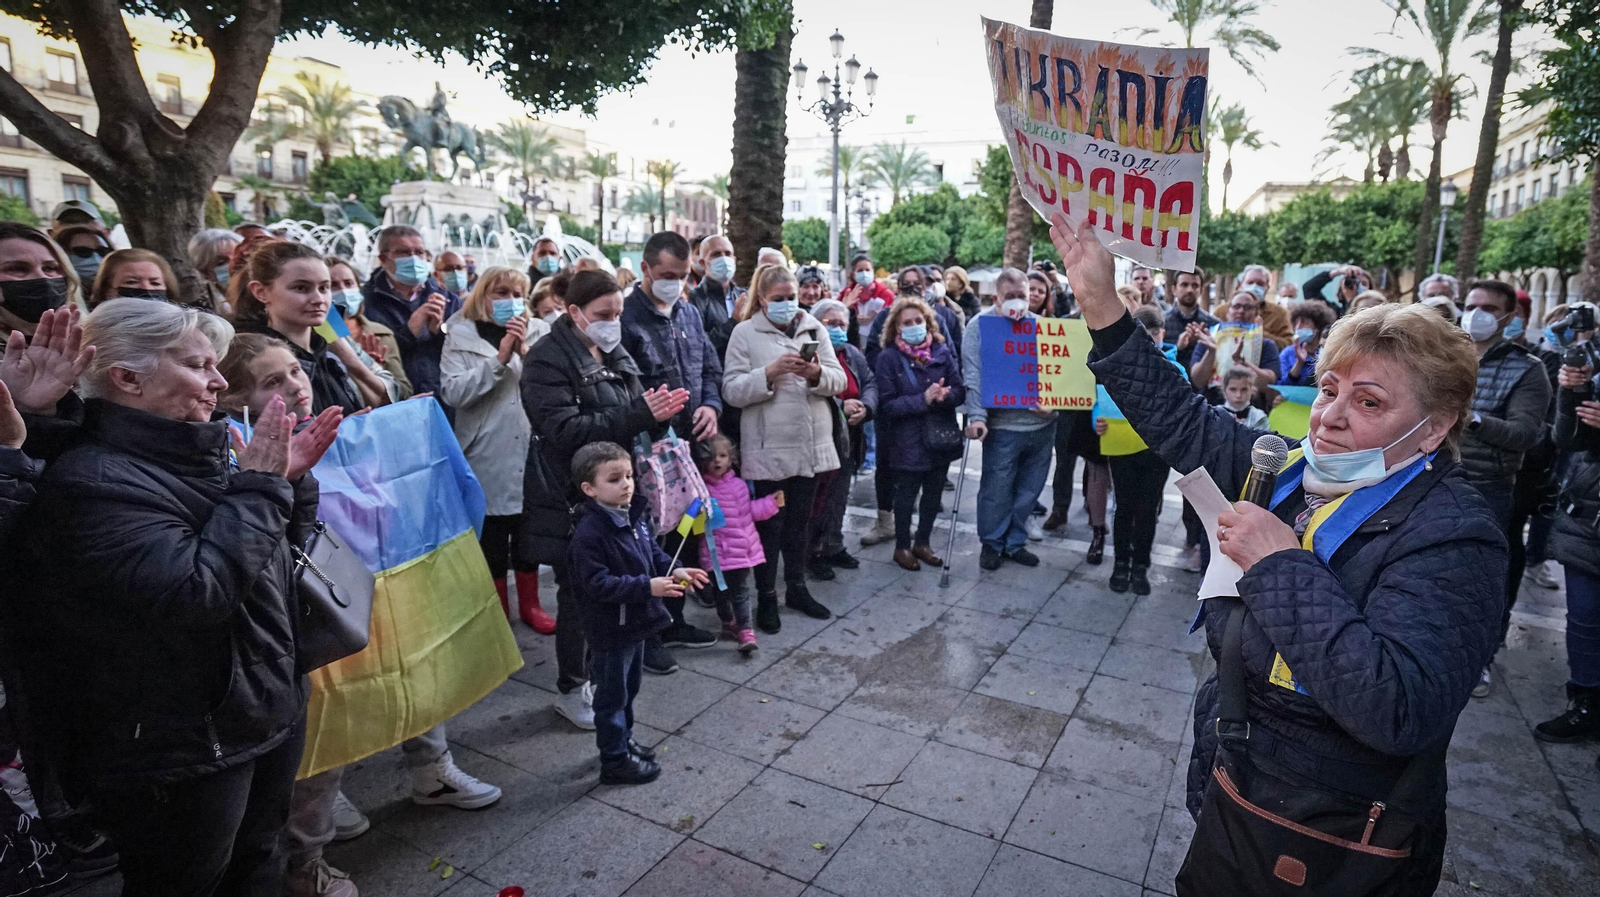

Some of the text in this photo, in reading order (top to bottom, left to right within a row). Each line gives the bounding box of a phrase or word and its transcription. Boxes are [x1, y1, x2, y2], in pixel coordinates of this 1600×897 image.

[1014, 128, 1194, 251] ESPAÑA
[1012, 321, 1066, 336] NO A LA
[1004, 341, 1070, 357] GUERRA
[1018, 363, 1061, 374] JEREZ
[1026, 382, 1052, 392] CON
[994, 395, 1092, 407] LOS UCRANIANOS
